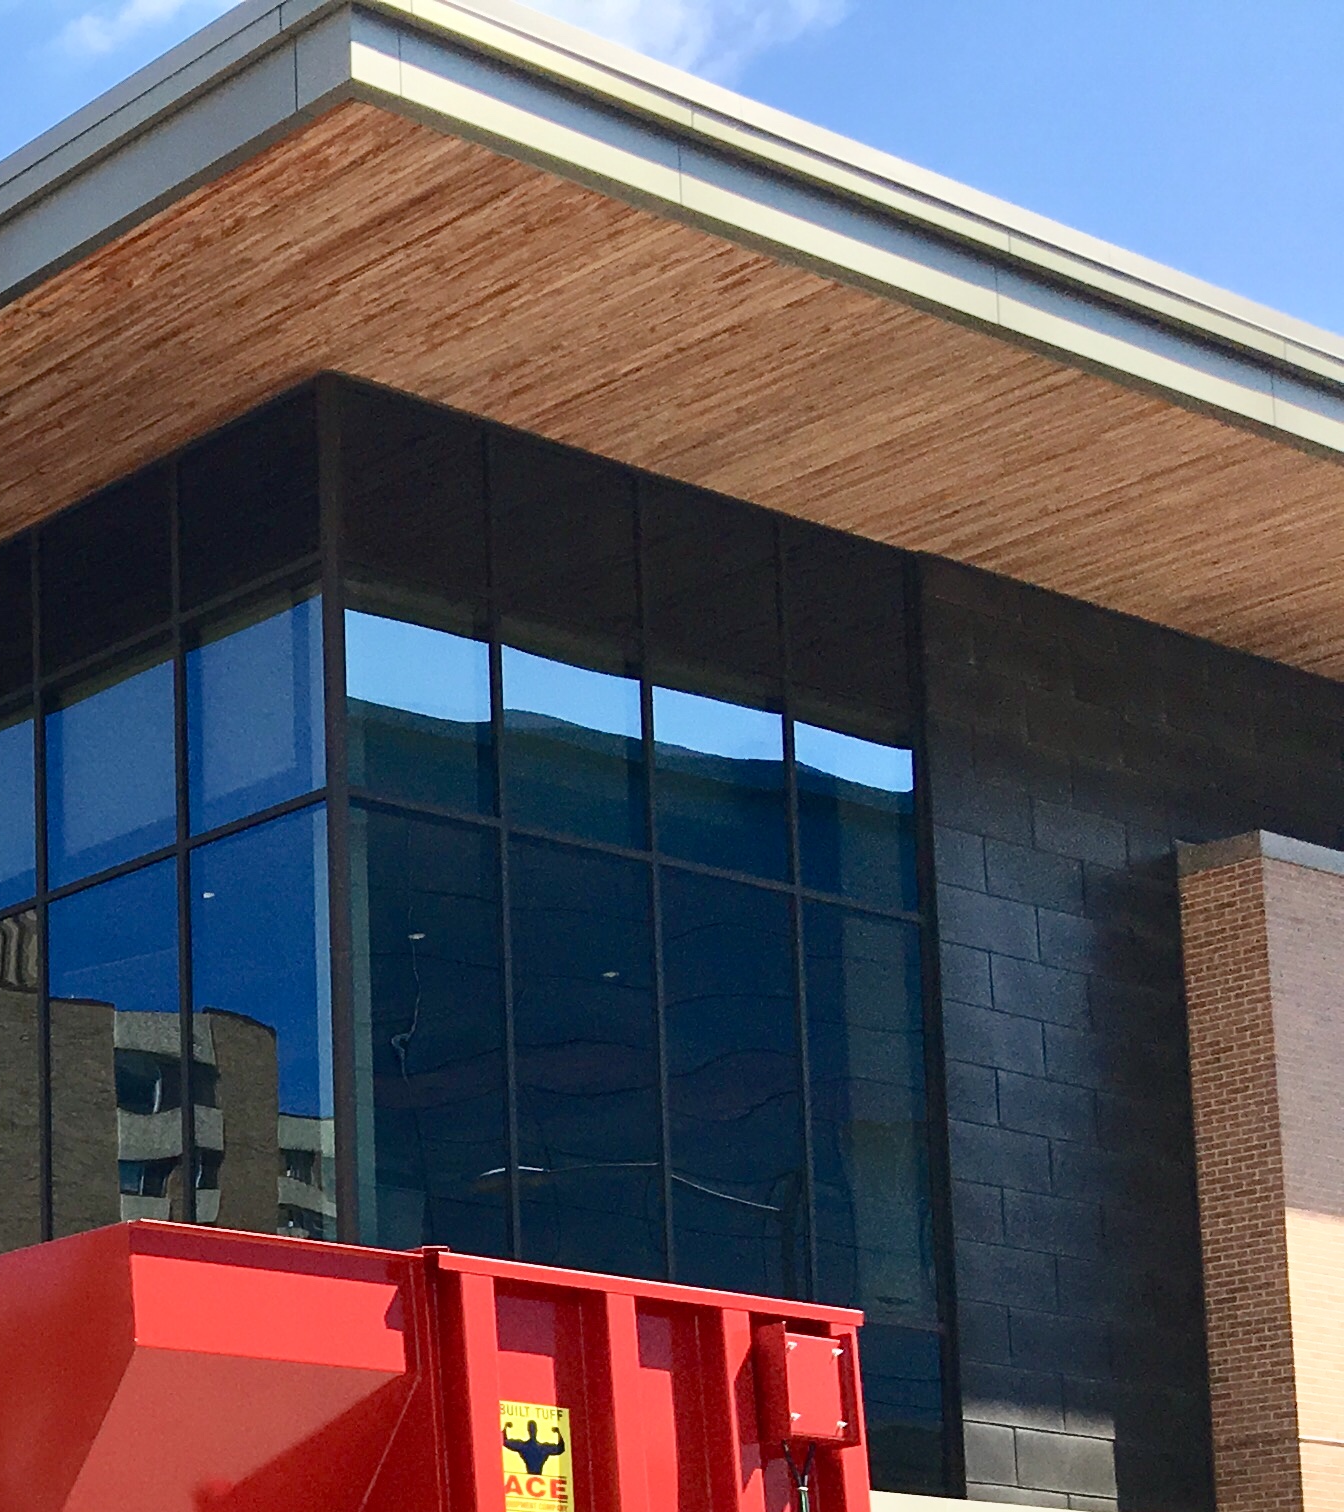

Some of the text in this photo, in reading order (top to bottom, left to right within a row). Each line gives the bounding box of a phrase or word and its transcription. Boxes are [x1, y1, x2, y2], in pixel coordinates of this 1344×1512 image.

[500, 1403, 563, 1421] BUILT TUFF
[504, 1475, 569, 1500] ACE
